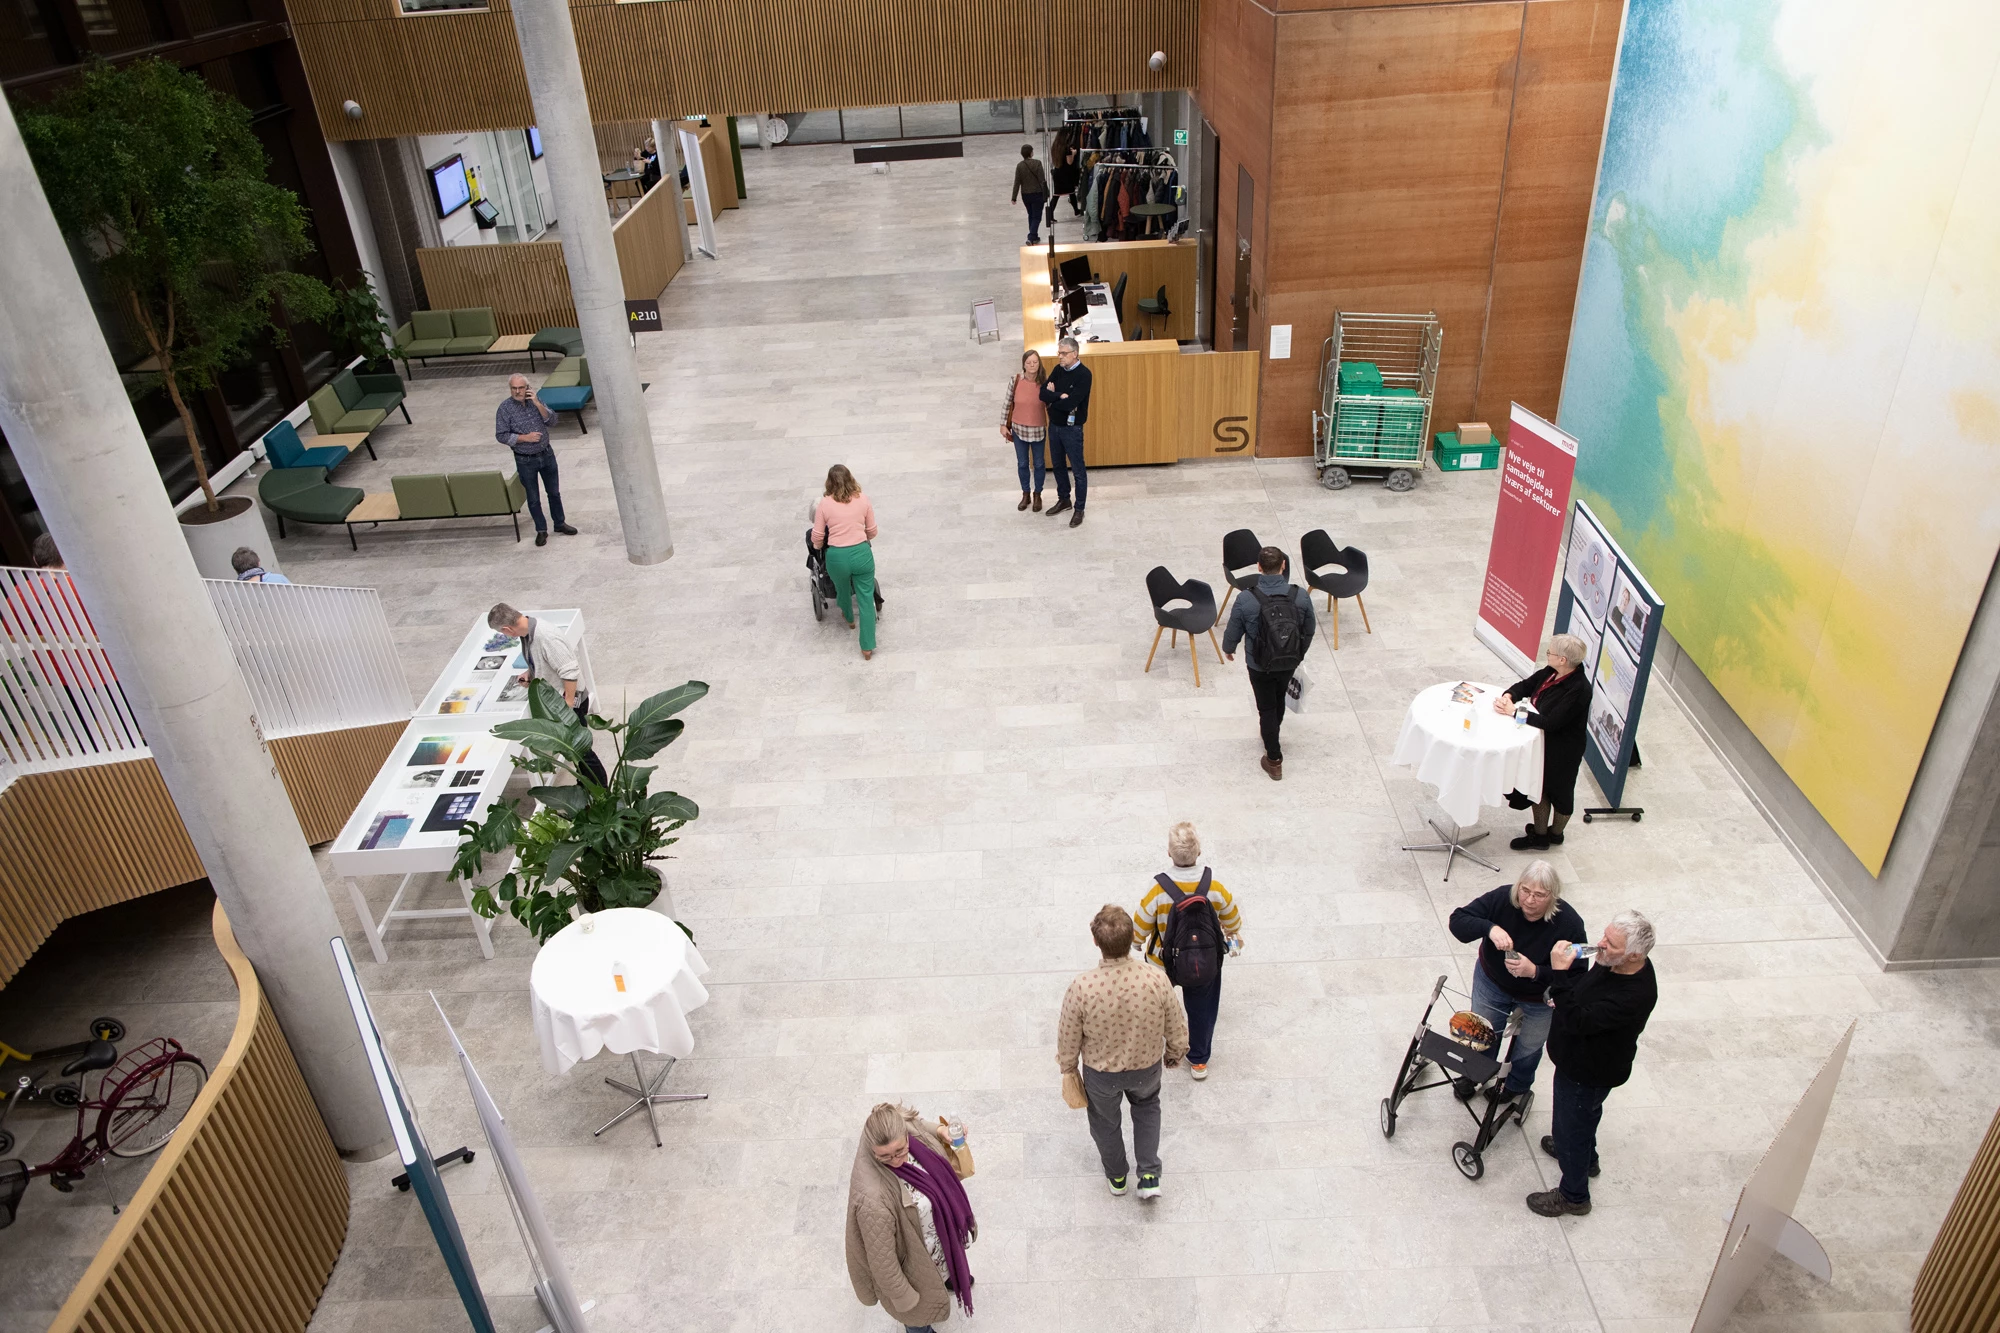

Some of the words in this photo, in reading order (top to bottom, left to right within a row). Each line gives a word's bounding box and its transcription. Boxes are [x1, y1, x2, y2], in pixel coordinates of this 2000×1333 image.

[630, 311, 657, 321] A210
[1508, 450, 1521, 464] Nye
[1522, 459, 1536, 473] veje
[1537, 468, 1545, 479] til
[1504, 474, 1524, 492] tværs
[1523, 488, 1532, 497] af
[1532, 493, 1561, 517] sektorer
[1506, 463, 1544, 493] samarbejde
[1544, 488, 1553, 499] på
